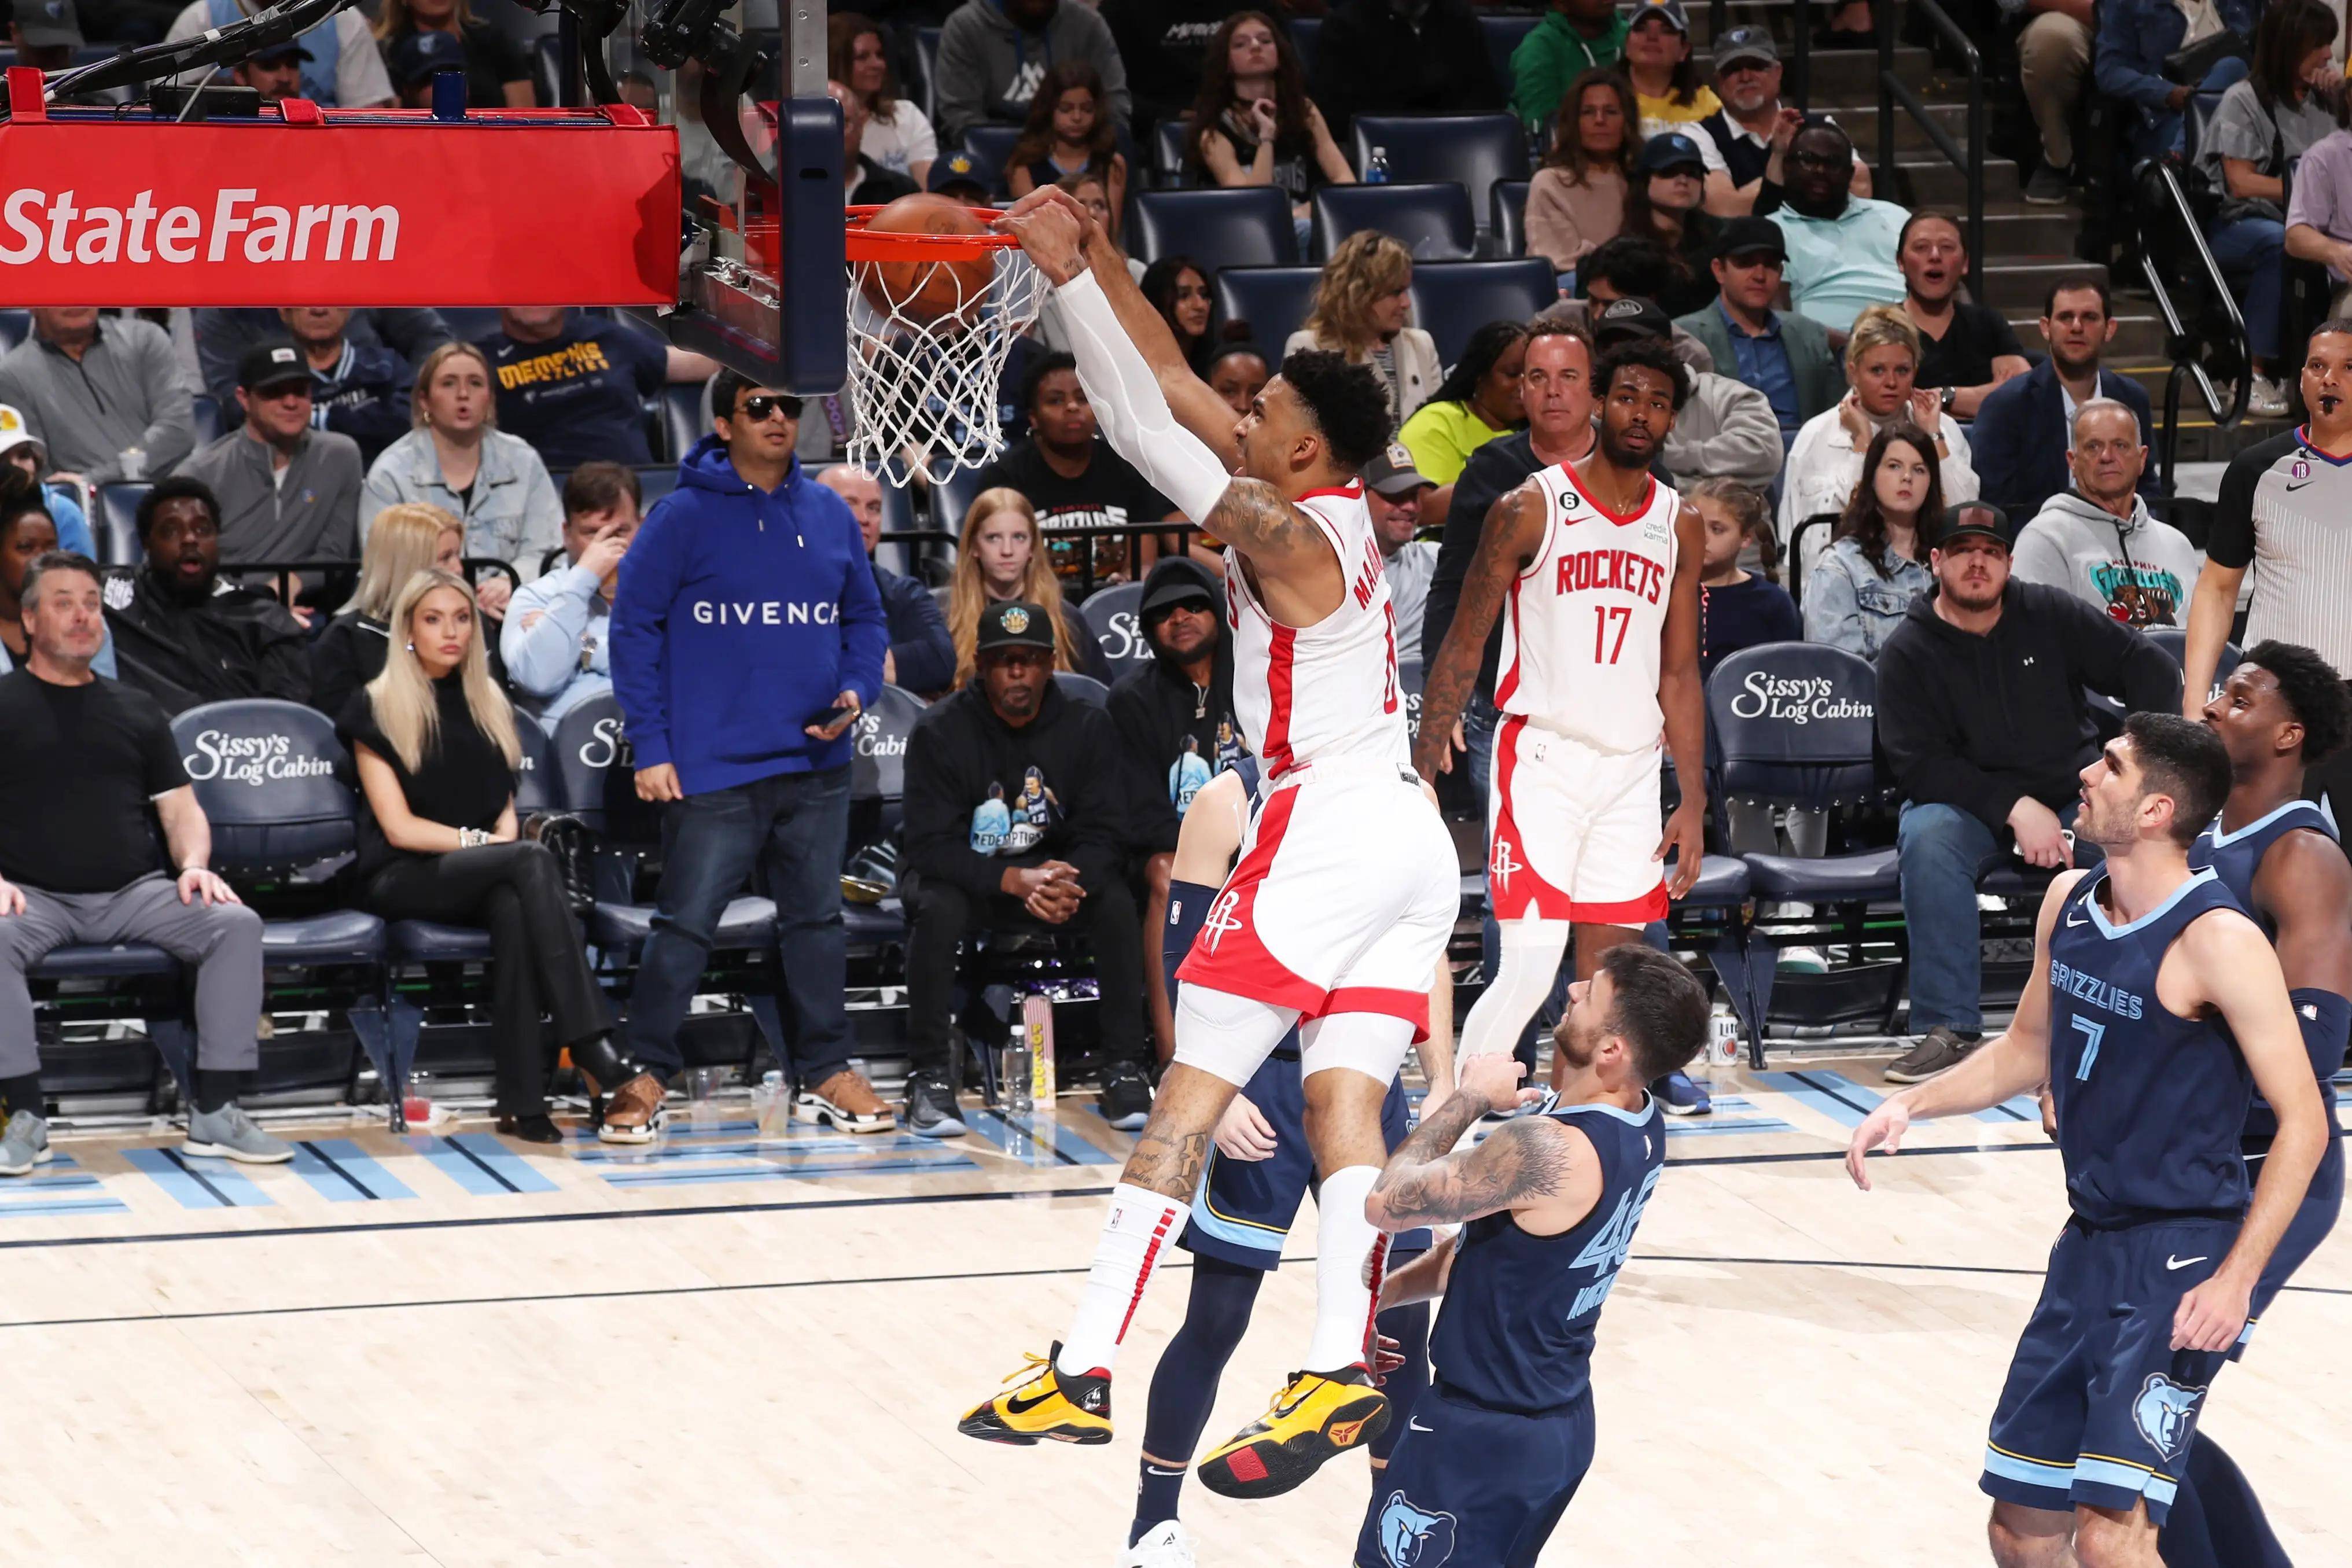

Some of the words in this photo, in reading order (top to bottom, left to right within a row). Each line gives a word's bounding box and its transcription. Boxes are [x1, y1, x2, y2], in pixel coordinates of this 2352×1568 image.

[1563, 494, 1577, 508] 6
[1644, 529, 1668, 544] karma
[1646, 522, 1666, 535] credit
[1556, 549, 1665, 605] ROCKETS
[2112, 560, 2158, 570] MEPHIS
[1595, 605, 1632, 665] 17
[1731, 671, 1833, 718] Sissy's
[1769, 698, 1809, 724] Log
[1812, 698, 1874, 719] Cabin
[183, 730, 290, 780] Sissy's
[857, 734, 907, 756] Cabi
[222, 757, 264, 786] Log
[267, 754, 333, 779] Cabin
[2051, 959, 2143, 1020] GRIZZLIES
[2071, 1013, 2106, 1081] 7
